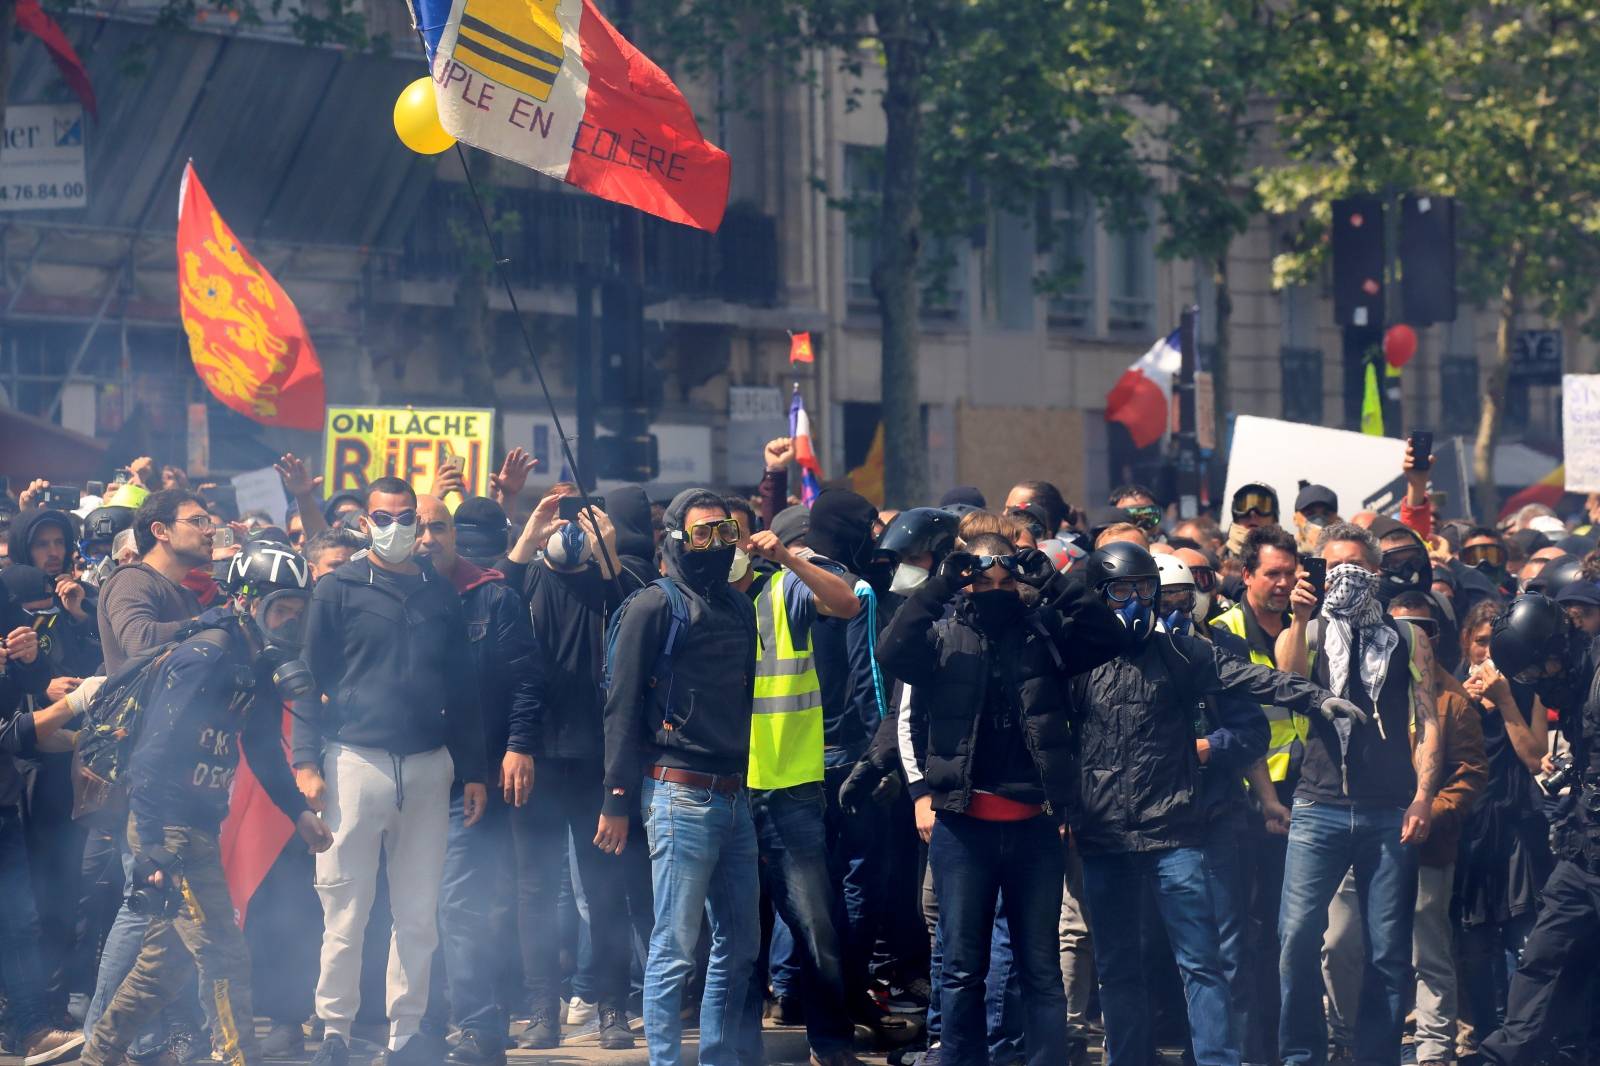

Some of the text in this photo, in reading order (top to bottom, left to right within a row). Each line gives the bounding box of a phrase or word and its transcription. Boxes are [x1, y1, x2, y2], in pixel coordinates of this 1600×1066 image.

[508, 97, 554, 138] EN
[572, 120, 688, 181] COLÈRE
[332, 413, 374, 433] ON
[260, 548, 309, 588] TV
